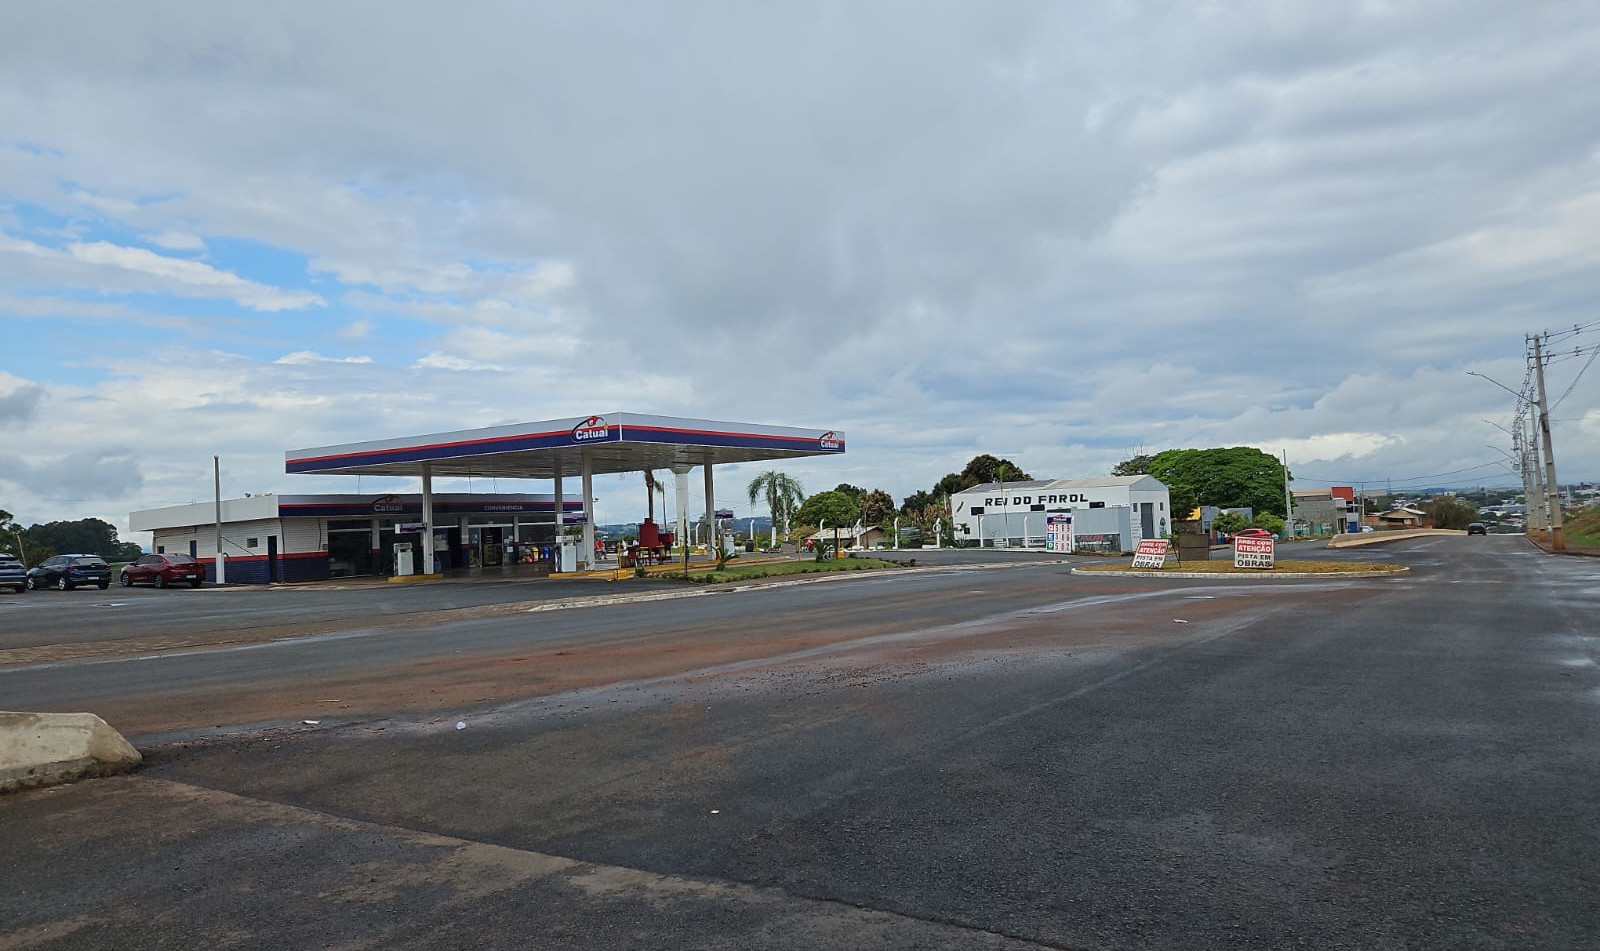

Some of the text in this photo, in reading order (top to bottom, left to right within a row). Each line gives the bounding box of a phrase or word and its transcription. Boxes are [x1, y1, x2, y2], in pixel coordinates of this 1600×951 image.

[985, 494, 1088, 506] REI DO FAROL
[1238, 544, 1271, 553] ATENÇÃO
[1134, 560, 1161, 569] OBRAS
[1237, 560, 1273, 568] OBRAS
